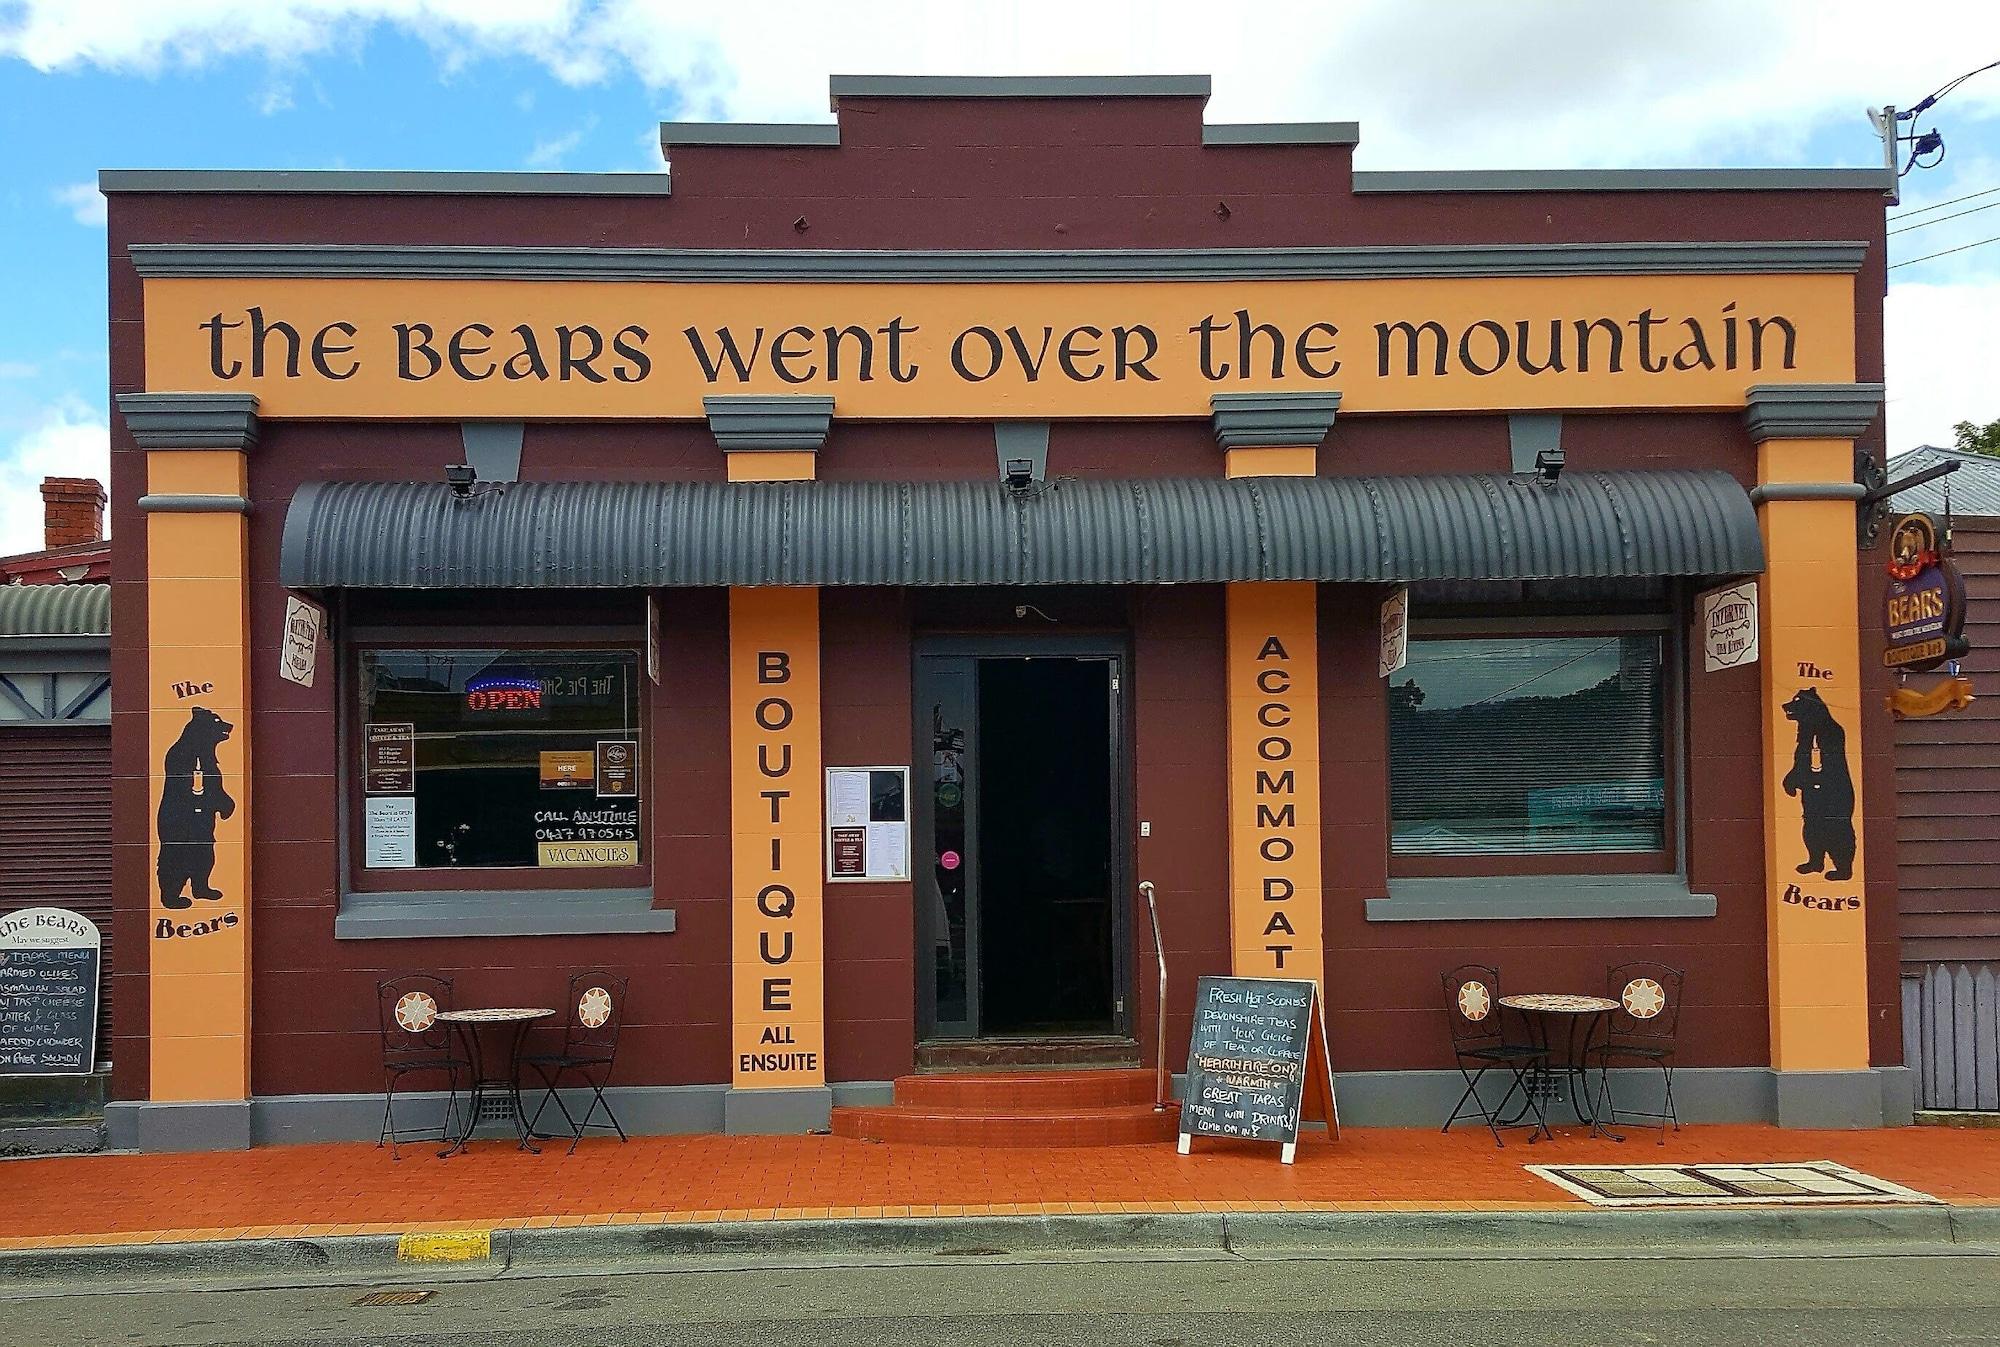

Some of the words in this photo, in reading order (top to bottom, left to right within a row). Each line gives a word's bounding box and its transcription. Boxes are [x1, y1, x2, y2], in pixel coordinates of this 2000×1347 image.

[1888, 587, 1943, 627] BEARS
[1797, 662, 1834, 680] The
[172, 680, 214, 699] The
[468, 690, 542, 710] OPEN
[557, 765, 577, 773] HERE
[1256, 636, 1296, 969] ACCOMMODAT
[534, 811, 569, 823] CALL
[572, 810, 637, 823] ANYTIME
[535, 828, 574, 840] 0427
[578, 828, 635, 839] 970545
[755, 651, 796, 1011] BOUTIQUE
[547, 847, 629, 862] VACANCIES
[1783, 884, 1861, 911] Bears
[155, 912, 239, 939] Bears
[12, 936, 27, 946] May
[42, 937, 69, 945] suggest
[57, 951, 90, 960] MENU
[0, 967, 37, 978] ARMED
[1209, 987, 1242, 1004] FRESH
[1245, 990, 1265, 1005] HOT
[0, 1011, 31, 1022] LATTER
[1203, 1009, 1265, 1026] DEVONSHIRE
[1267, 1016, 1298, 1030] TEAS
[2, 1024, 18, 1034] OF
[760, 1026, 795, 1045] ALL
[0, 1037, 35, 1047] AFOOD
[740, 1053, 817, 1072] ENSUITE
[1226, 1074, 1271, 1089] WARMTH
[1202, 1087, 1243, 1104] GREAT
[1249, 1092, 1285, 1108] TAPAS
[1189, 1104, 1215, 1118] MENU
